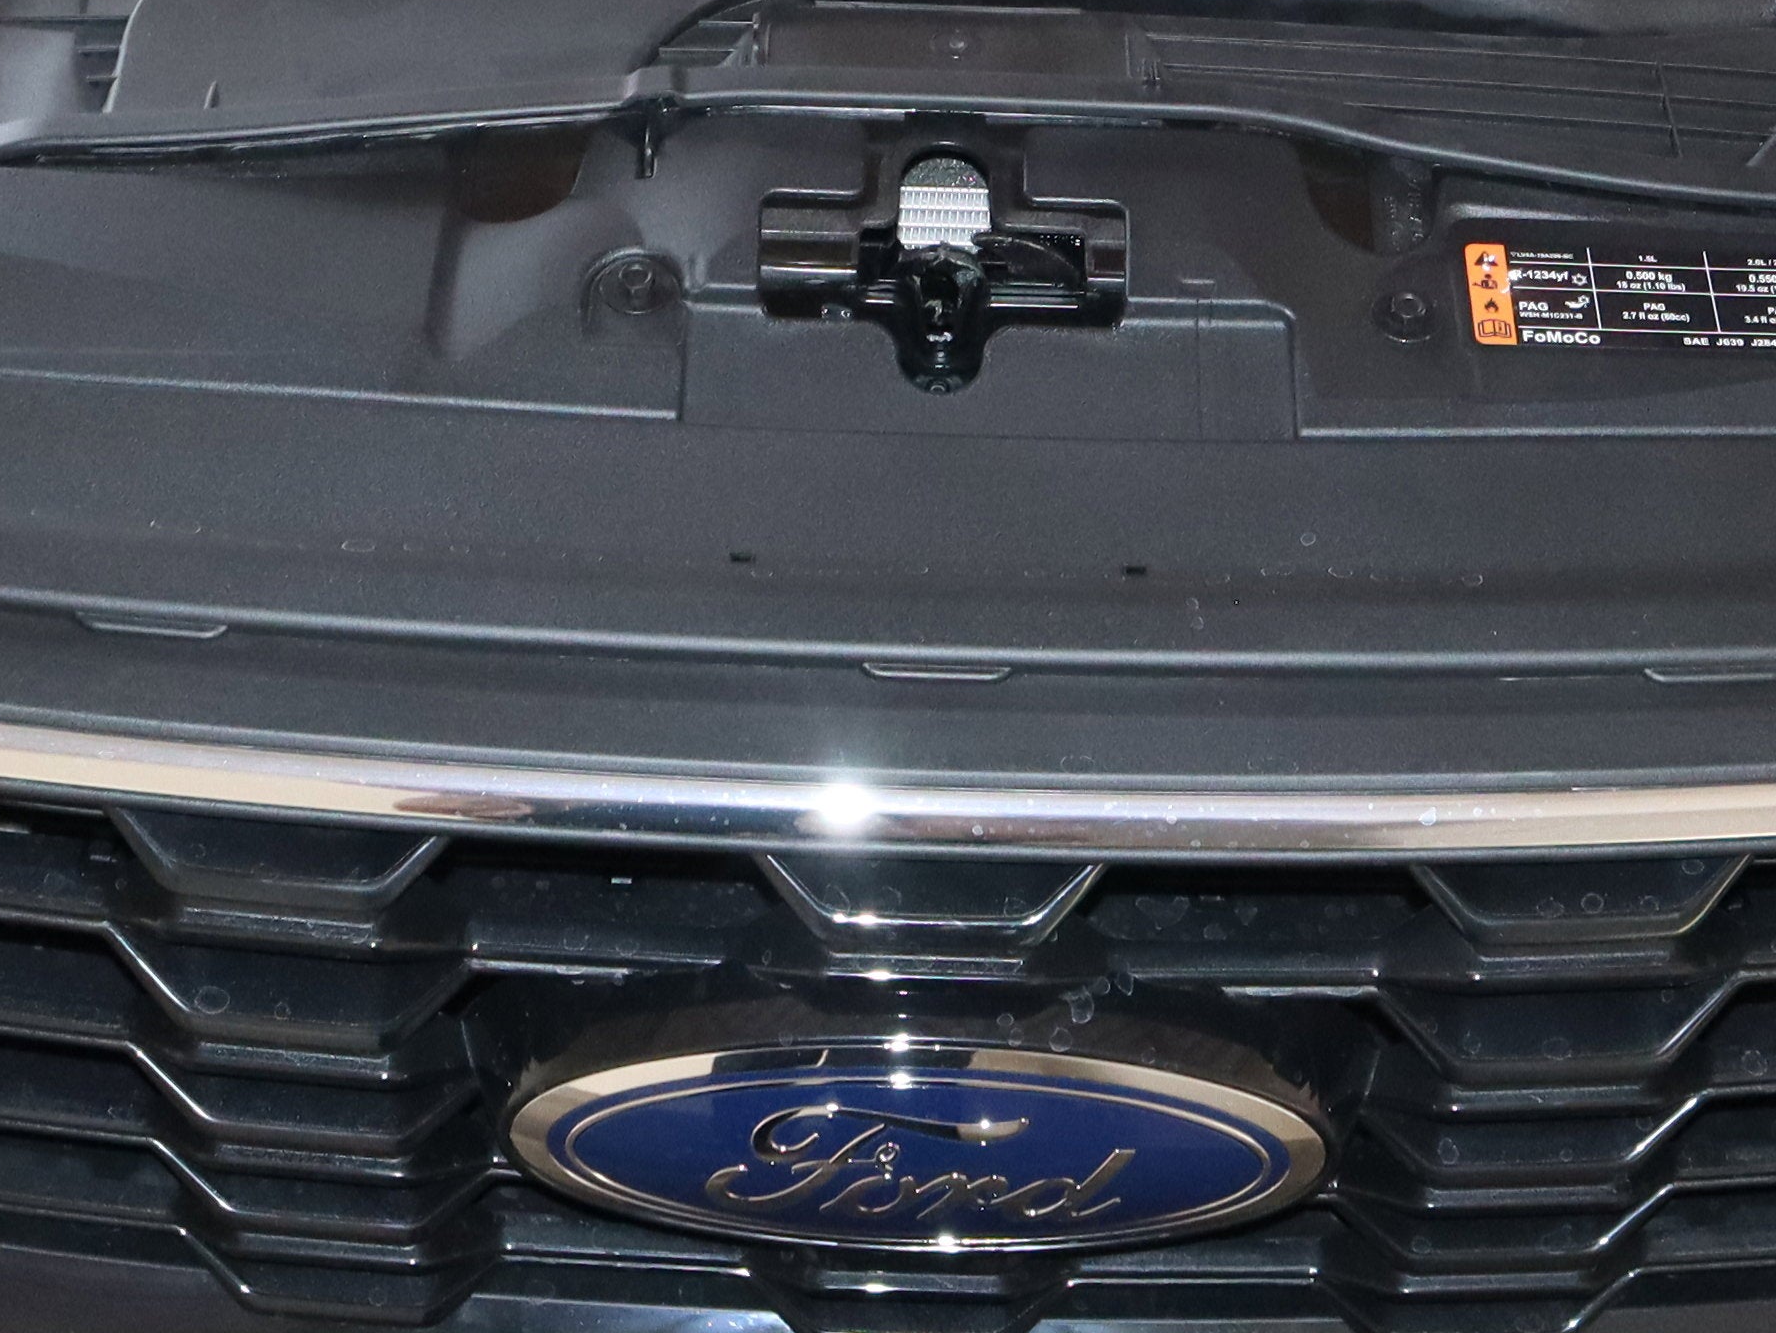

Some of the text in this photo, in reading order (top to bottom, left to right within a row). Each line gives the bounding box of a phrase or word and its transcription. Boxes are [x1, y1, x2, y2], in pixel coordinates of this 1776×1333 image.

[1625, 271, 1673, 283] 0.500 kg
[1643, 282, 1666, 291] (1.10
[1667, 283, 1686, 292] lbs)
[1735, 284, 1756, 292] 19.5
[1518, 301, 1549, 311] PAG
[1643, 303, 1666, 311] PAG
[1622, 312, 1636, 320] 2.7
[1639, 312, 1646, 320] fl
[1744, 316, 1759, 324] 3.4
[1760, 316, 1768, 324] fl
[1522, 330, 1601, 344] FoMoCo
[1683, 337, 1710, 346] SAE
[1716, 338, 1745, 347] J639
[705, 1104, 1139, 1221] Ford
